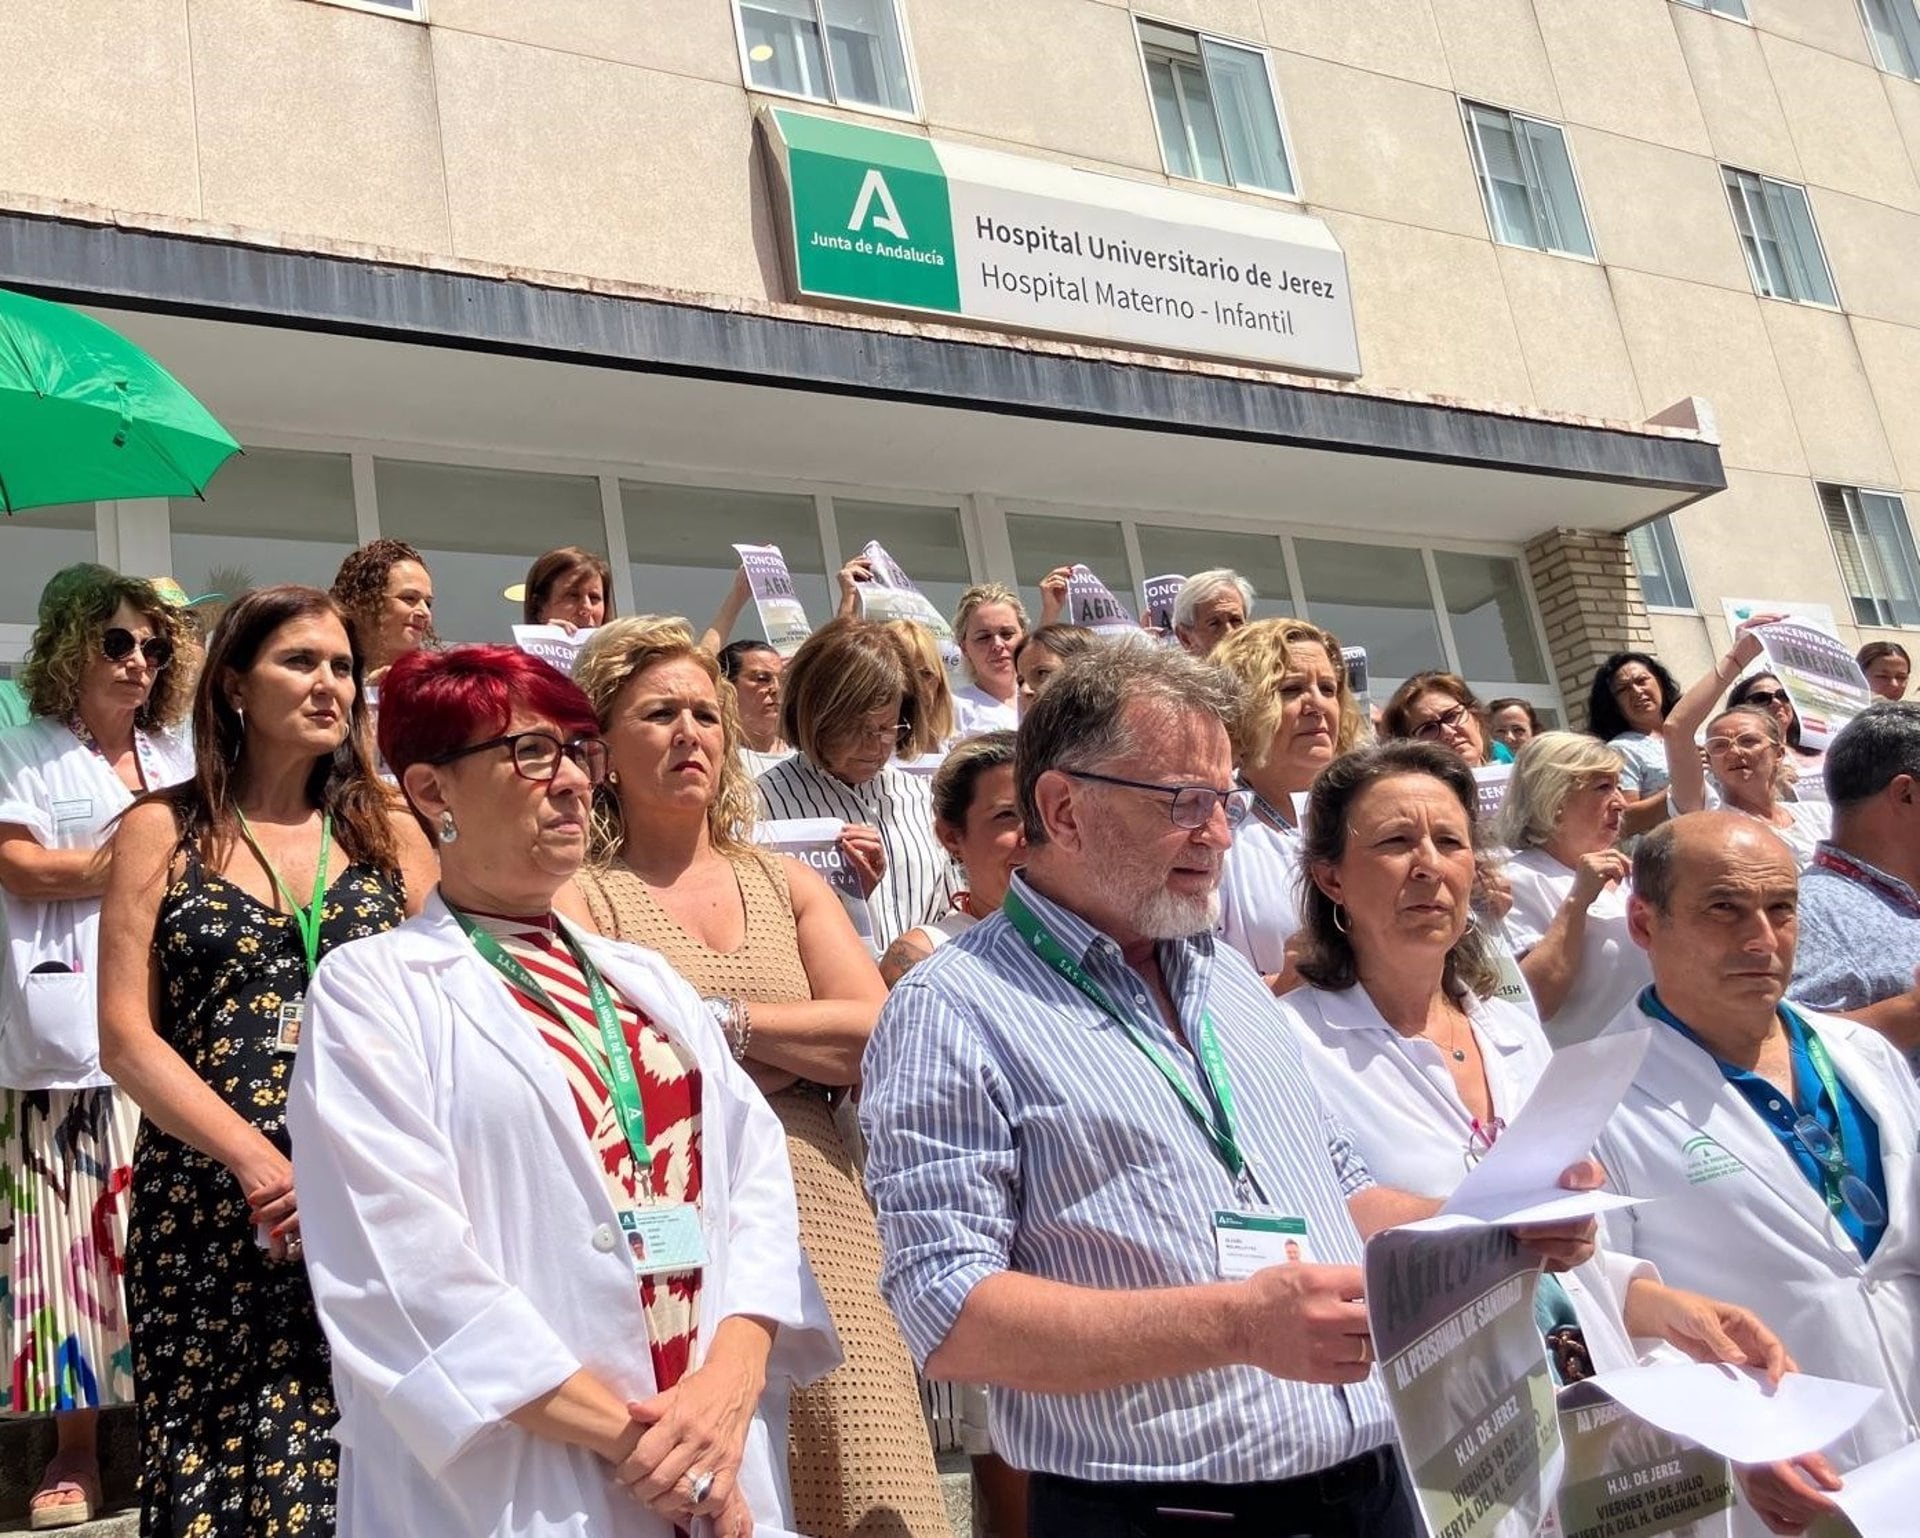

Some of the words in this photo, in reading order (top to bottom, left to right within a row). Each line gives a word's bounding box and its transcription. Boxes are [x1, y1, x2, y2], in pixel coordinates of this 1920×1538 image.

[811, 232, 852, 250] Junta
[855, 238, 873, 254] de
[876, 242, 944, 265] Andalucía
[976, 216, 1083, 256] Hospital
[1088, 235, 1240, 283] Universitario
[1246, 263, 1272, 288] de
[1278, 270, 1335, 299] Jerez
[981, 262, 1089, 303] Hospital
[1095, 280, 1195, 320] Materno
[1215, 300, 1294, 335] Infantil
[610, 1040, 622, 1054] DE
[614, 1055, 631, 1083] SALUD
[1407, 1315, 1466, 1379] PERSONAL
[1476, 1419, 1494, 1445] DE
[1491, 1395, 1521, 1433] JEREZ
[1451, 1456, 1494, 1507] VIERNES
[1596, 1493, 1643, 1520] VIERNES
[1658, 1483, 1674, 1501] DE
[1674, 1474, 1704, 1495] JULIO
[1606, 1475, 1633, 1496] H.U.
[1632, 1469, 1650, 1486] DE
[1650, 1460, 1682, 1482] JEREZ
[1474, 1492, 1495, 1519] DEL
[1616, 1513, 1638, 1533] DEL
[1653, 1493, 1700, 1520] GENERAL
